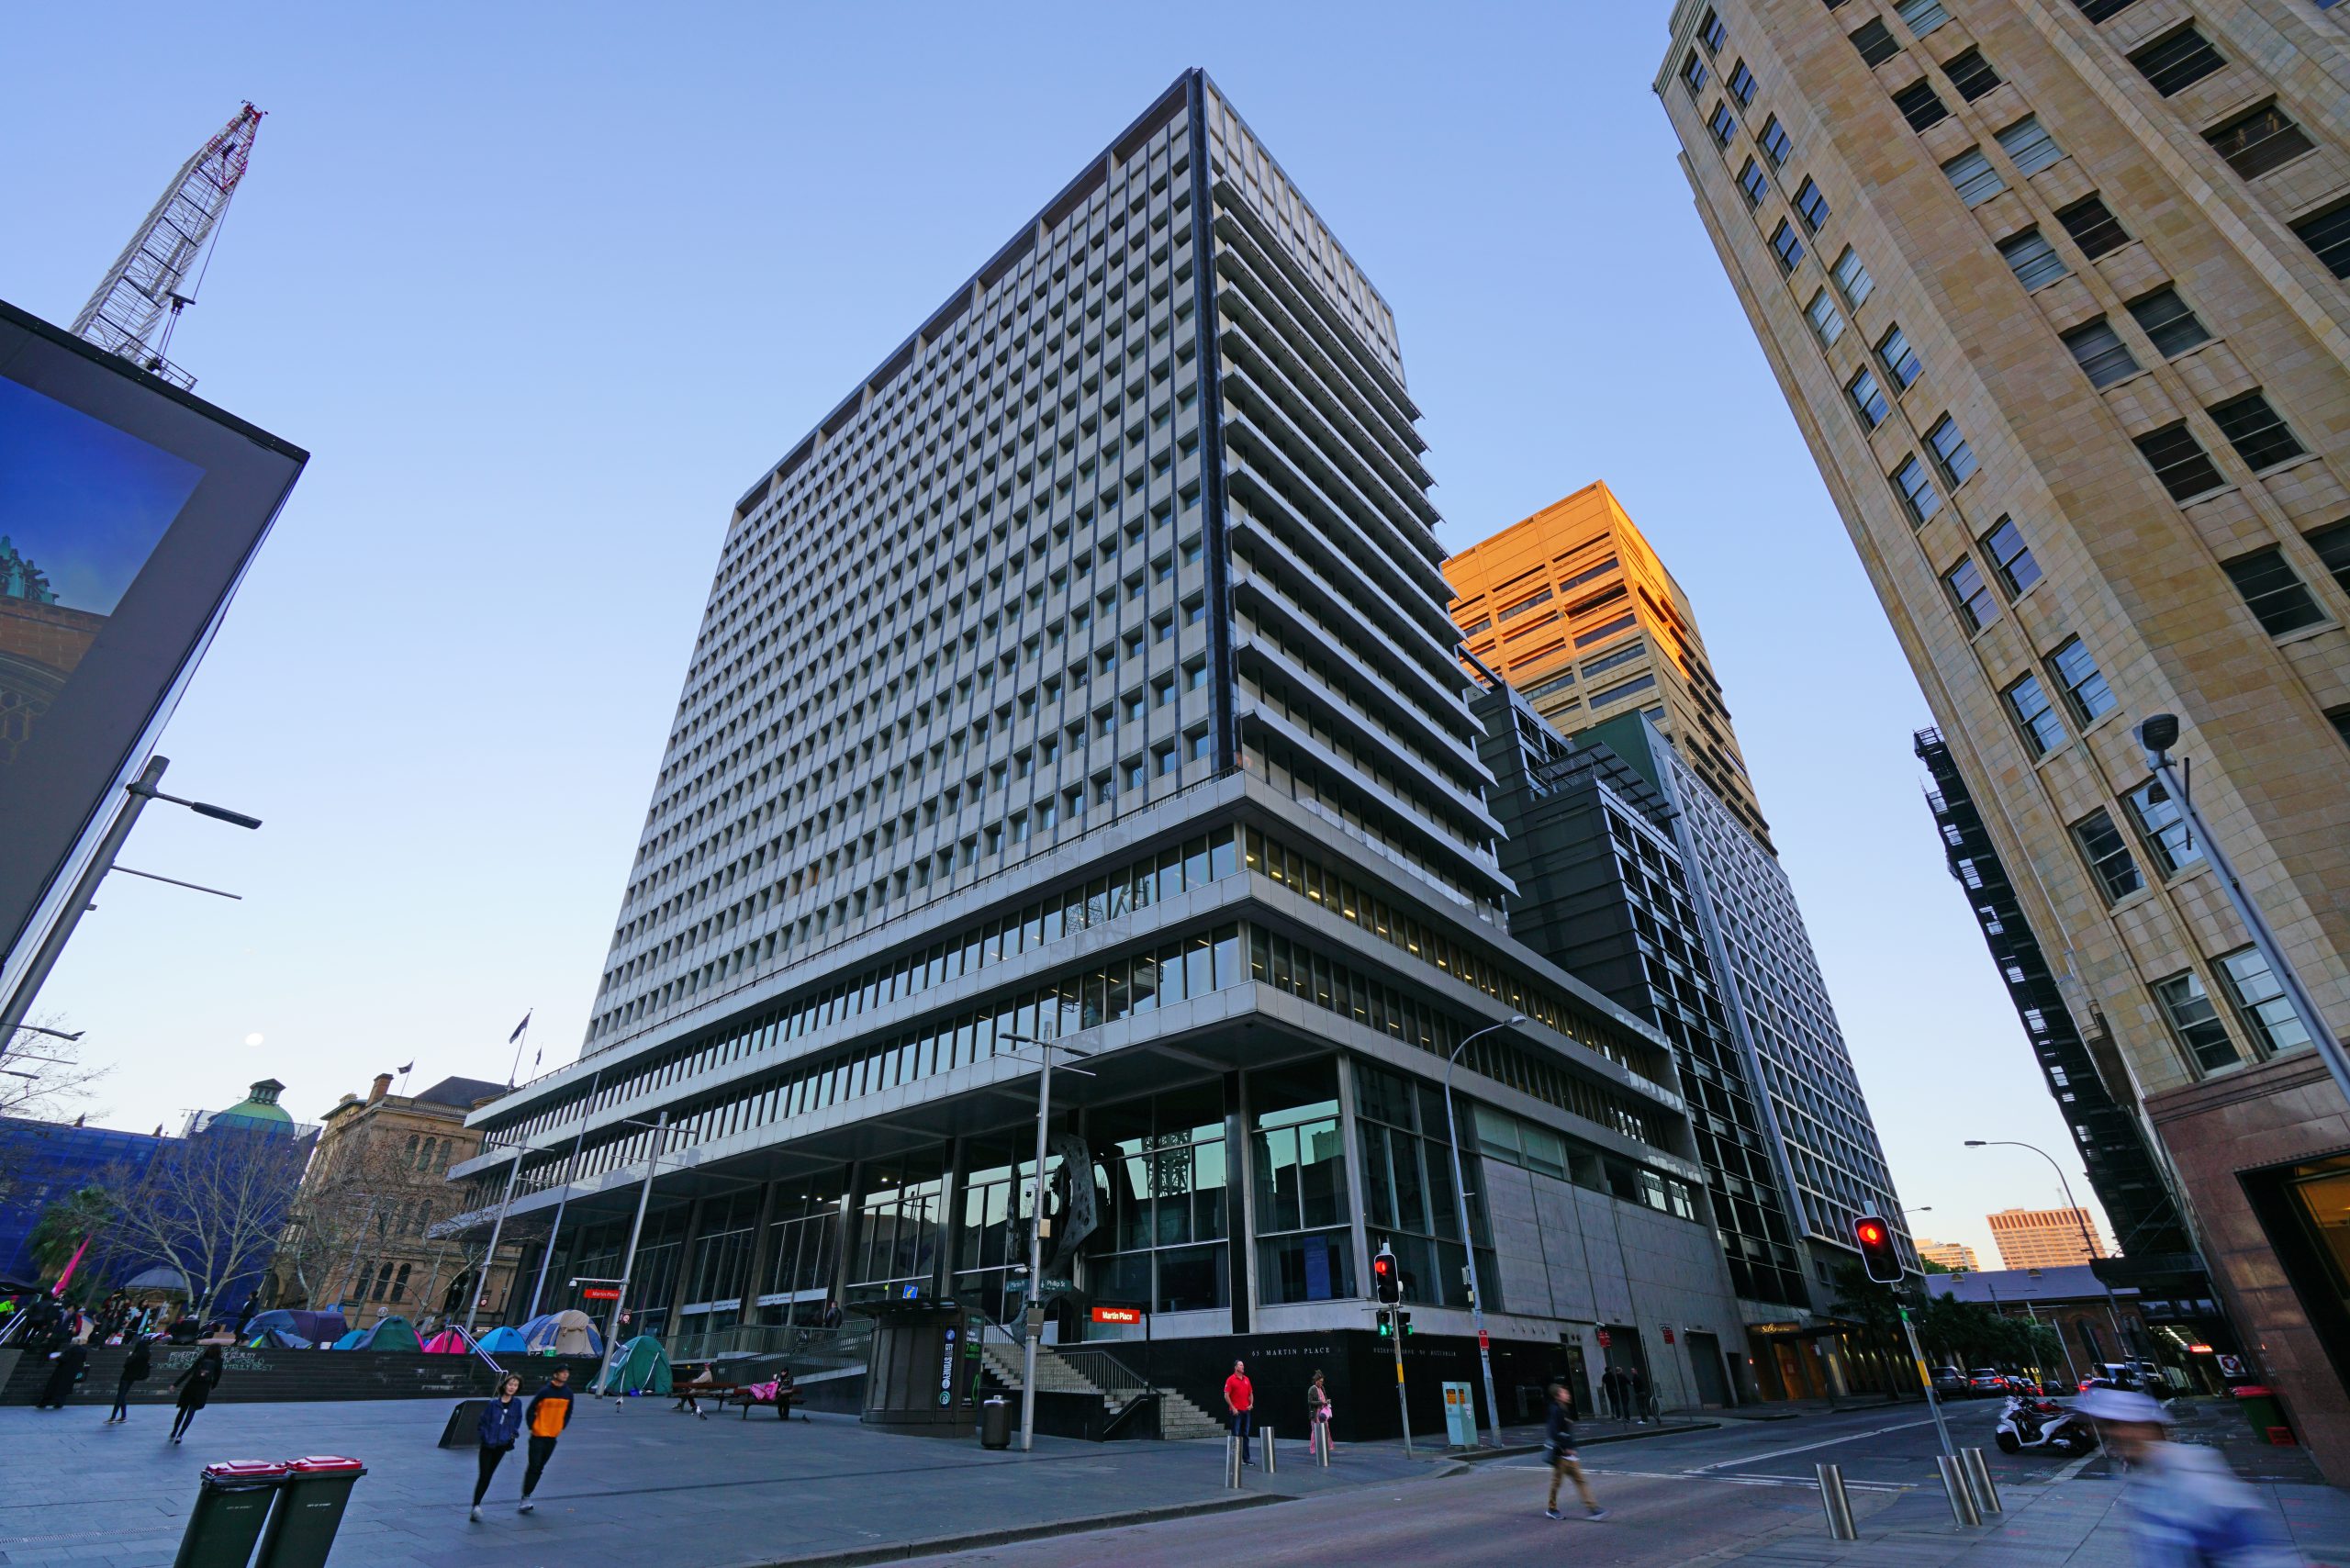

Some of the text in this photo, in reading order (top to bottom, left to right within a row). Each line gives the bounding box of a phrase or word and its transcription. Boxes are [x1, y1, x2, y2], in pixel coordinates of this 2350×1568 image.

[1102, 1311, 1133, 1321] Martin Place
[942, 1357, 953, 1380] SYDNEY
